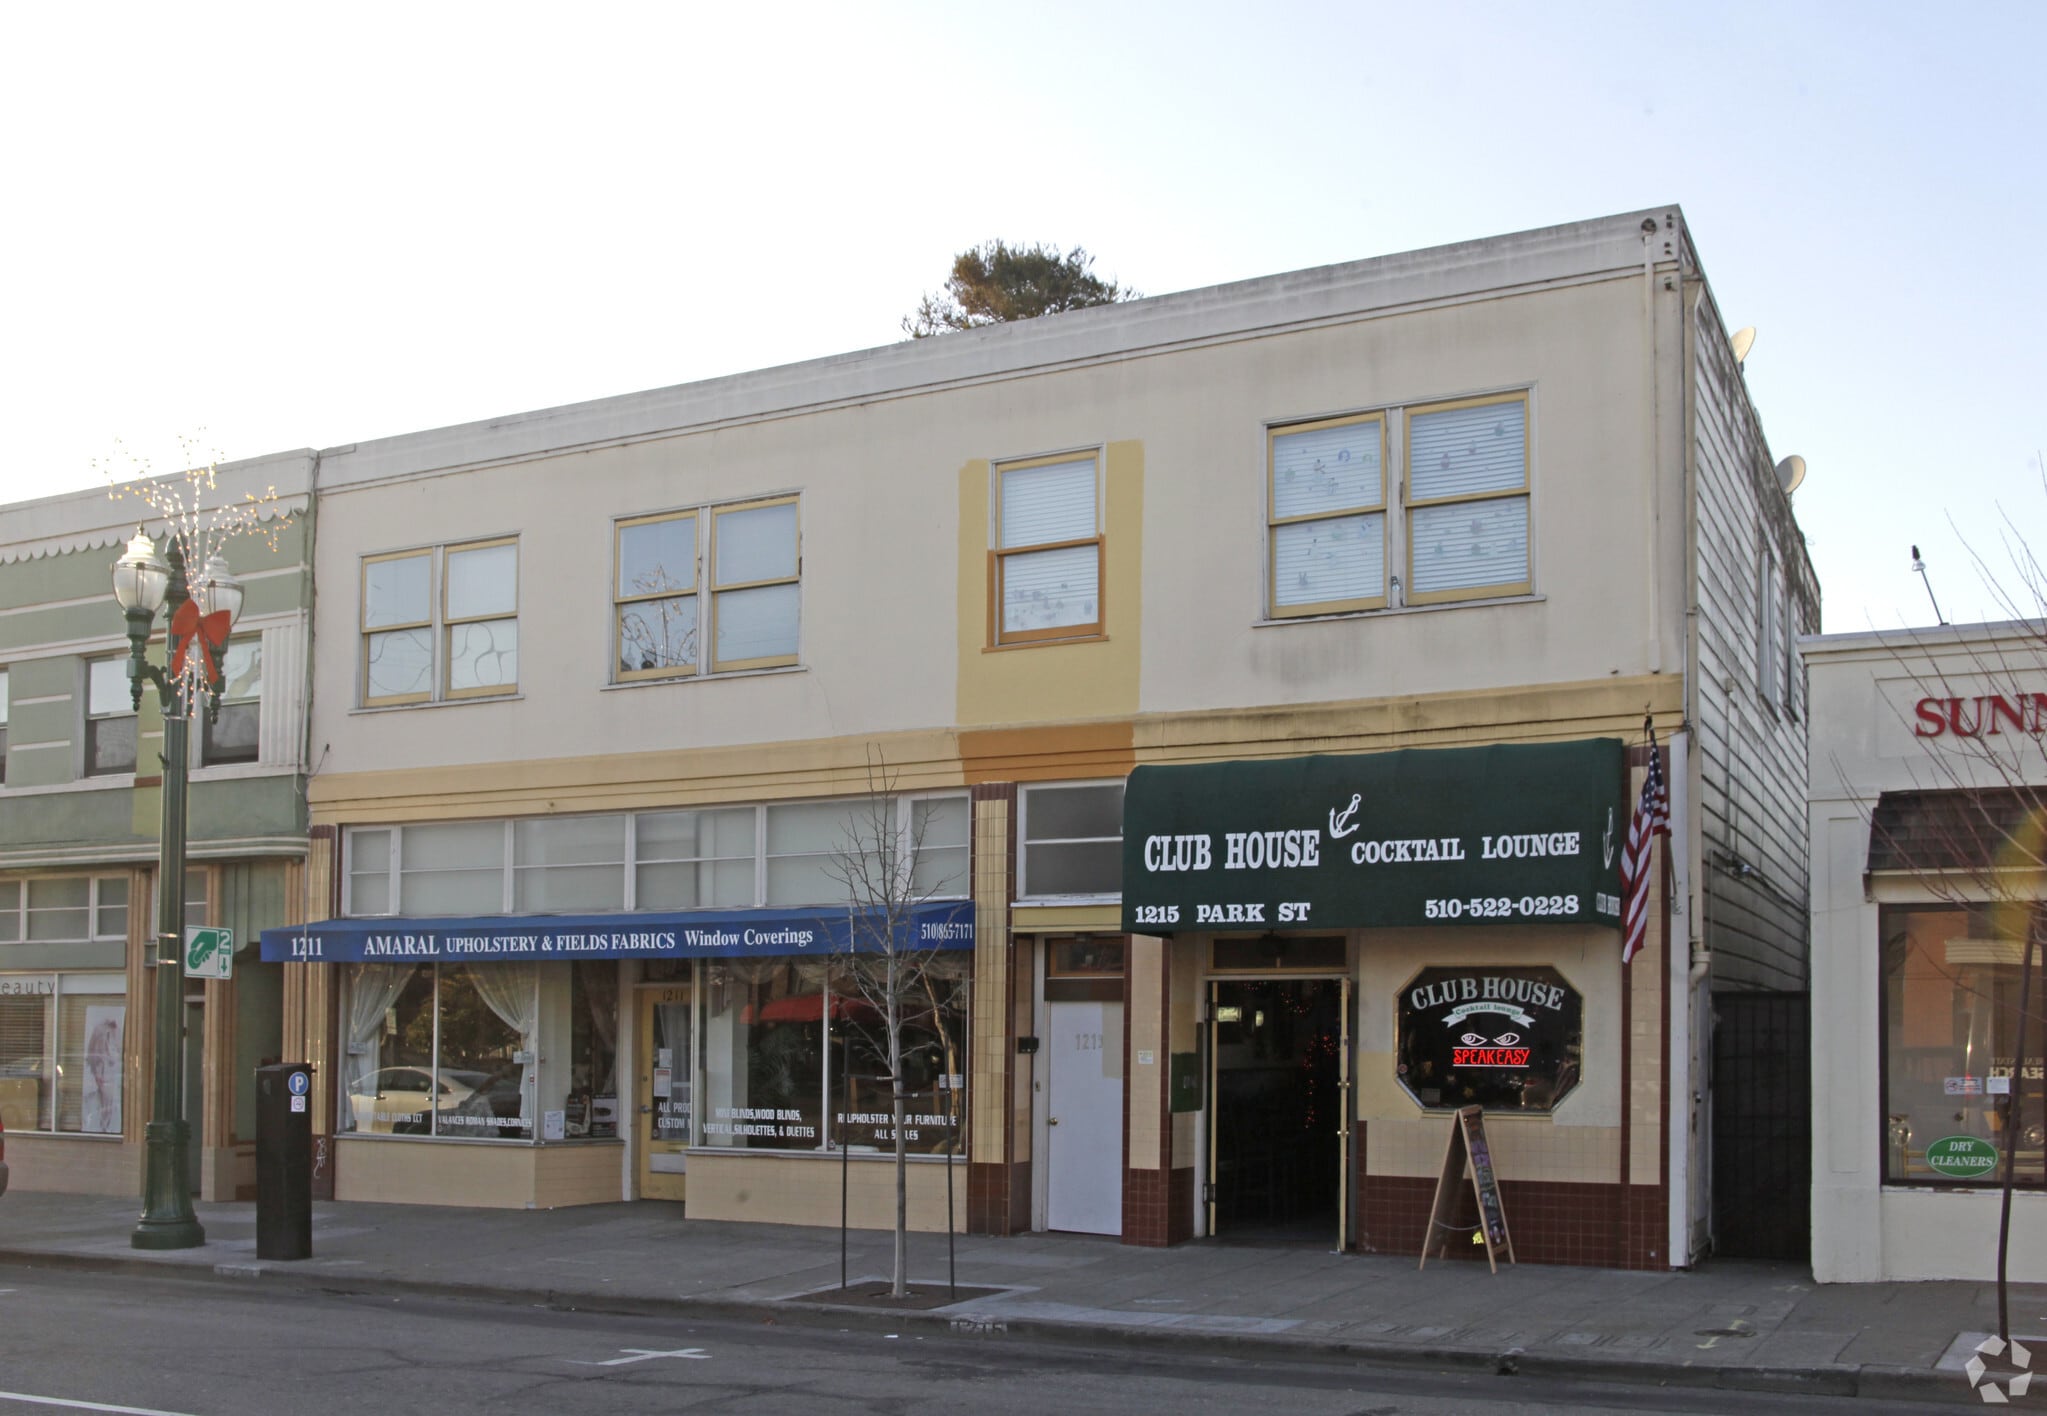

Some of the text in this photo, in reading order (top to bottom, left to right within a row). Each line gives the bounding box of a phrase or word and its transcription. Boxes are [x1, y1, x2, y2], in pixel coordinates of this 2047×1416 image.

[1144, 829, 1580, 872] CLUB HOUSE COCKTAIL LOUNGE
[1135, 902, 1311, 923] 1215 PARK ST
[1425, 895, 1580, 918] 510-522-0228
[219, 931, 231, 950] 2
[291, 927, 813, 956] 1211 AMARAL UPHOLSTERY & FIELDS FABRICS Window Coverings
[1411, 976, 1565, 1011] CLUB HOUSE
[1456, 1004, 1491, 1016] Cocktail
[1453, 1049, 1531, 1065] SPEAKEASY
[295, 1076, 304, 1092] P
[658, 1101, 671, 1112] ALL
[658, 1117, 685, 1128] CUSTOM
[838, 1113, 888, 1124] RUPHOLSTER
[874, 1129, 888, 1139] ALL
[1949, 1141, 1974, 1152] DRY
[1931, 1155, 1993, 1167] CLEANERS
